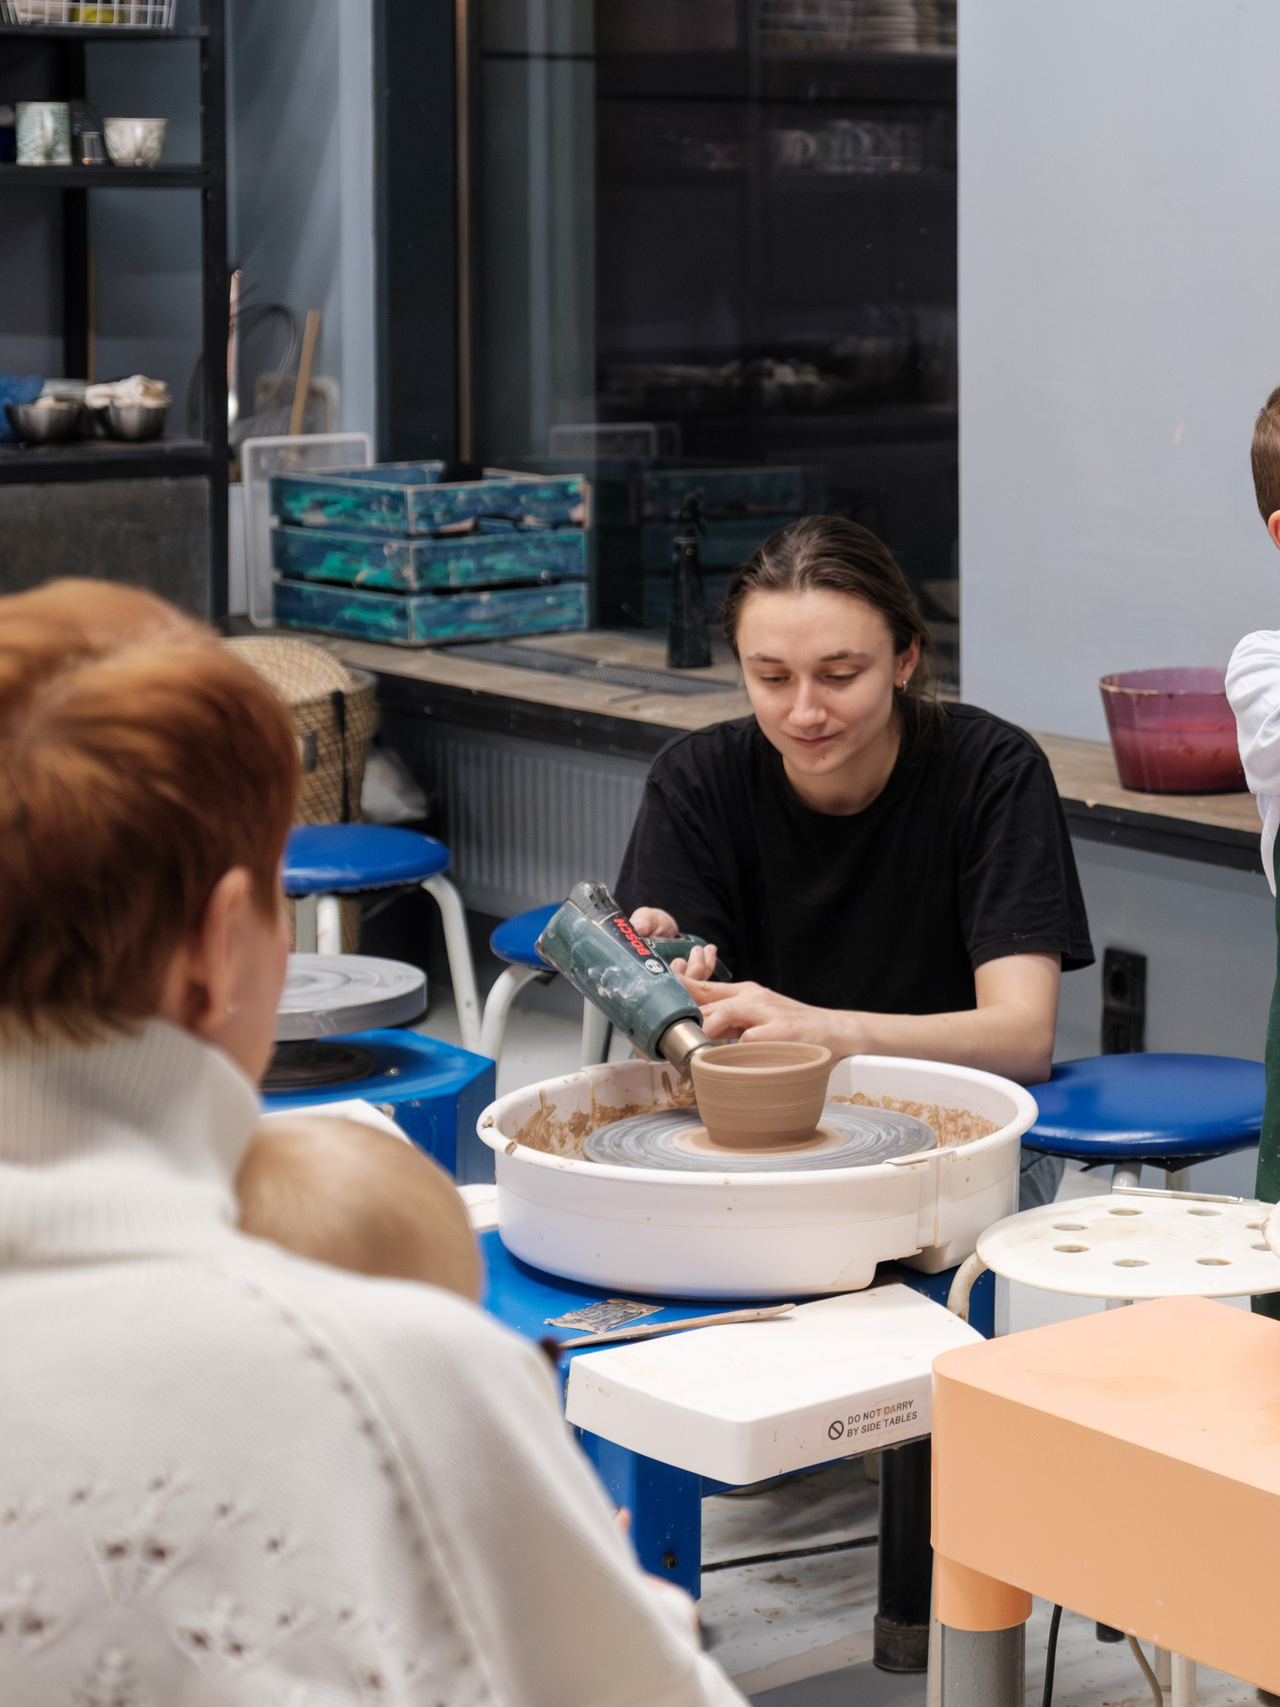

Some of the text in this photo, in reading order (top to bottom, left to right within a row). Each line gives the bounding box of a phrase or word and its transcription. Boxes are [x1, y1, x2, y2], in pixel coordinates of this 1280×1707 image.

[613, 918, 651, 956] BOSCH
[847, 1399, 914, 1425] DO NOT CARRY
[847, 1411, 918, 1438] BY SIDE TABLES
